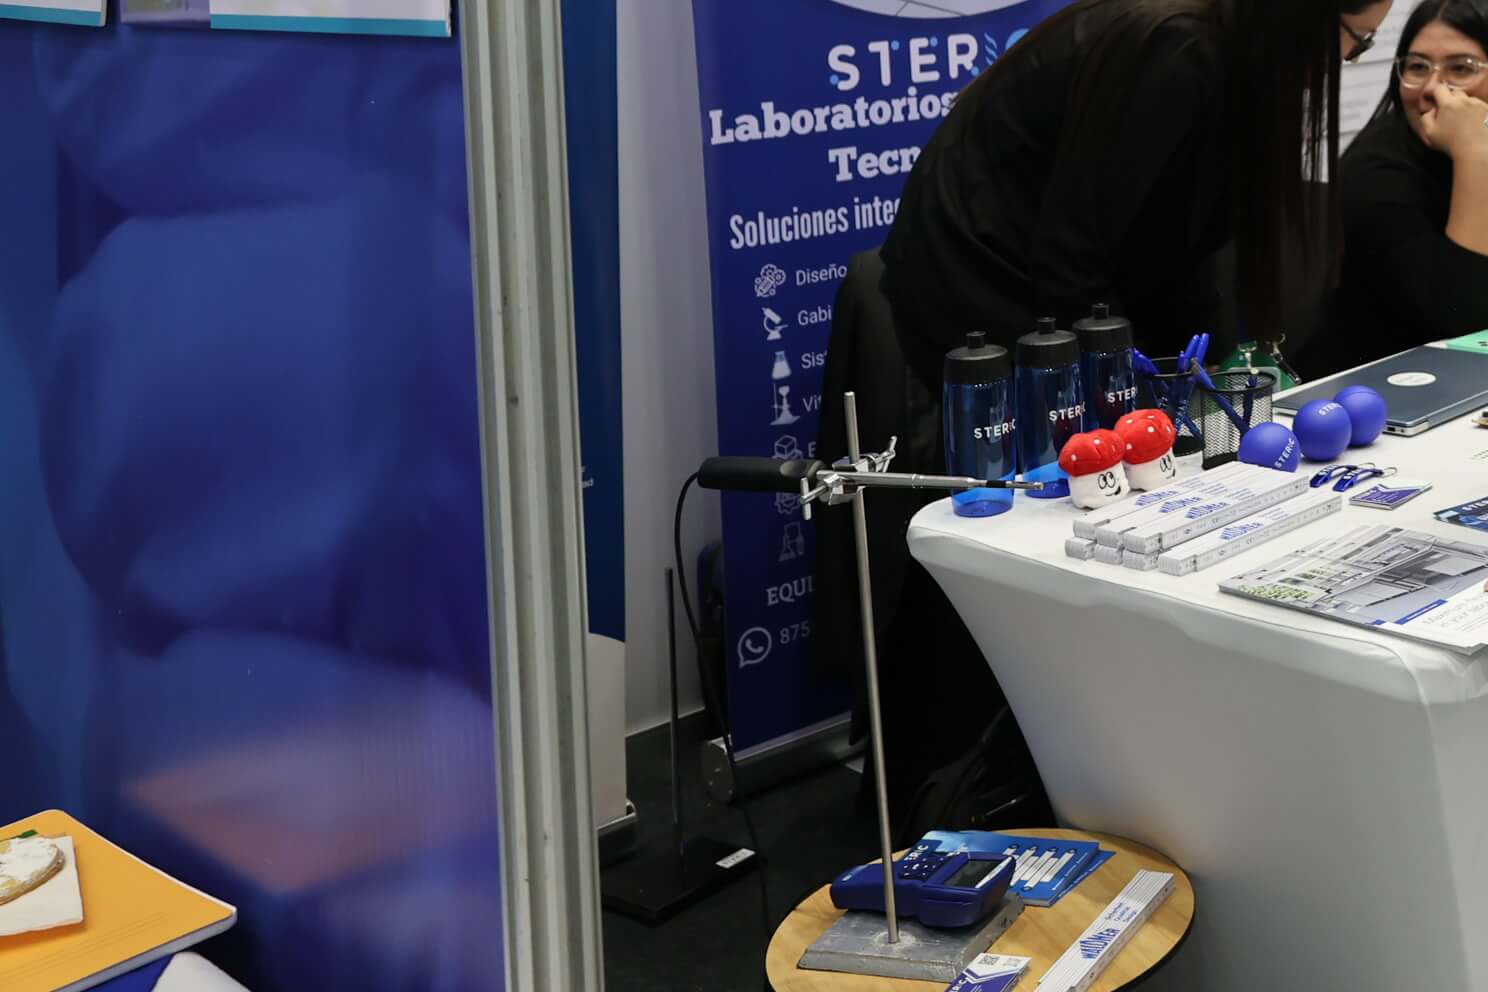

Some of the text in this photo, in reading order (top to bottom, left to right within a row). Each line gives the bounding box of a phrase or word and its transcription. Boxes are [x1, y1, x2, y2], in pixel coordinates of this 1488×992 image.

[828, 28, 1030, 91] STERI
[729, 202, 849, 250] Soluciones
[796, 263, 848, 286] Diseño
[797, 305, 832, 326] Gabi
[801, 350, 828, 369] Sis
[766, 575, 813, 606] EQUI
[1079, 927, 1121, 959] WALDNER
